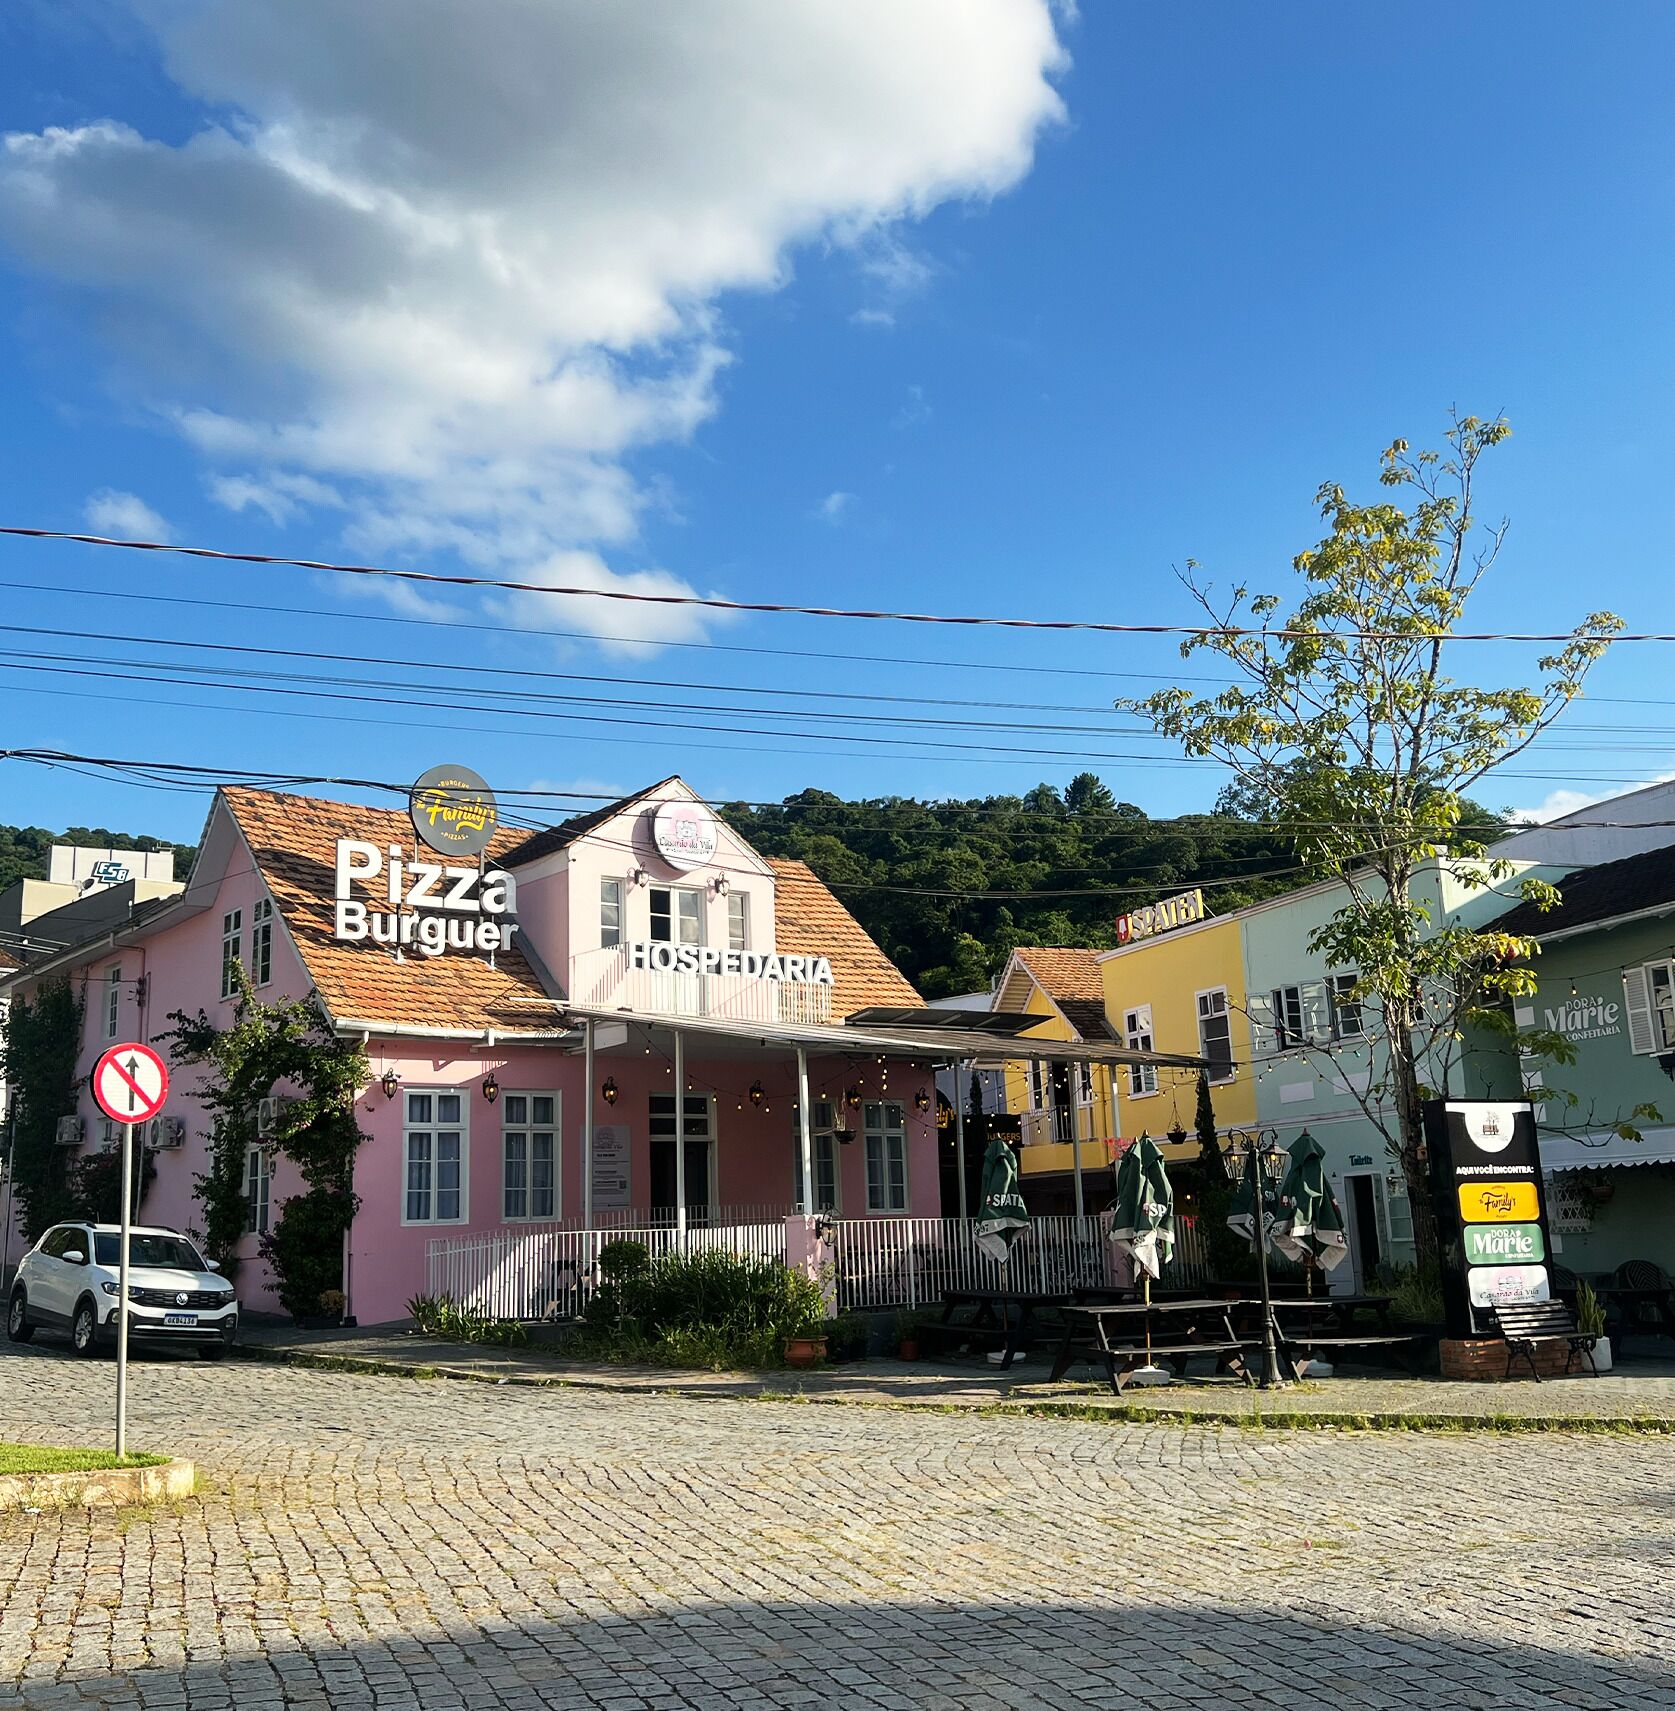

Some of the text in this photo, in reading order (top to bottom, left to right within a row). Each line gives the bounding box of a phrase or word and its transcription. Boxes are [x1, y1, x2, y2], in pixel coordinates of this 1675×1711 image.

[444, 831, 466, 841] PIZZAS
[337, 839, 518, 915] Pizza
[1131, 888, 1205, 940] SPATEN
[336, 899, 520, 956] Burguer
[628, 940, 836, 985] HOSPEDARIA
[1544, 996, 1620, 1033] Marie
[1565, 996, 1598, 1012] DORA
[1566, 1025, 1621, 1042] CONFEITARIA
[1456, 1166, 1474, 1176] AQUI
[1474, 1164, 1493, 1175] VOCÊ
[1473, 1229, 1534, 1255] Marie
[1491, 1228, 1517, 1239] DORA
